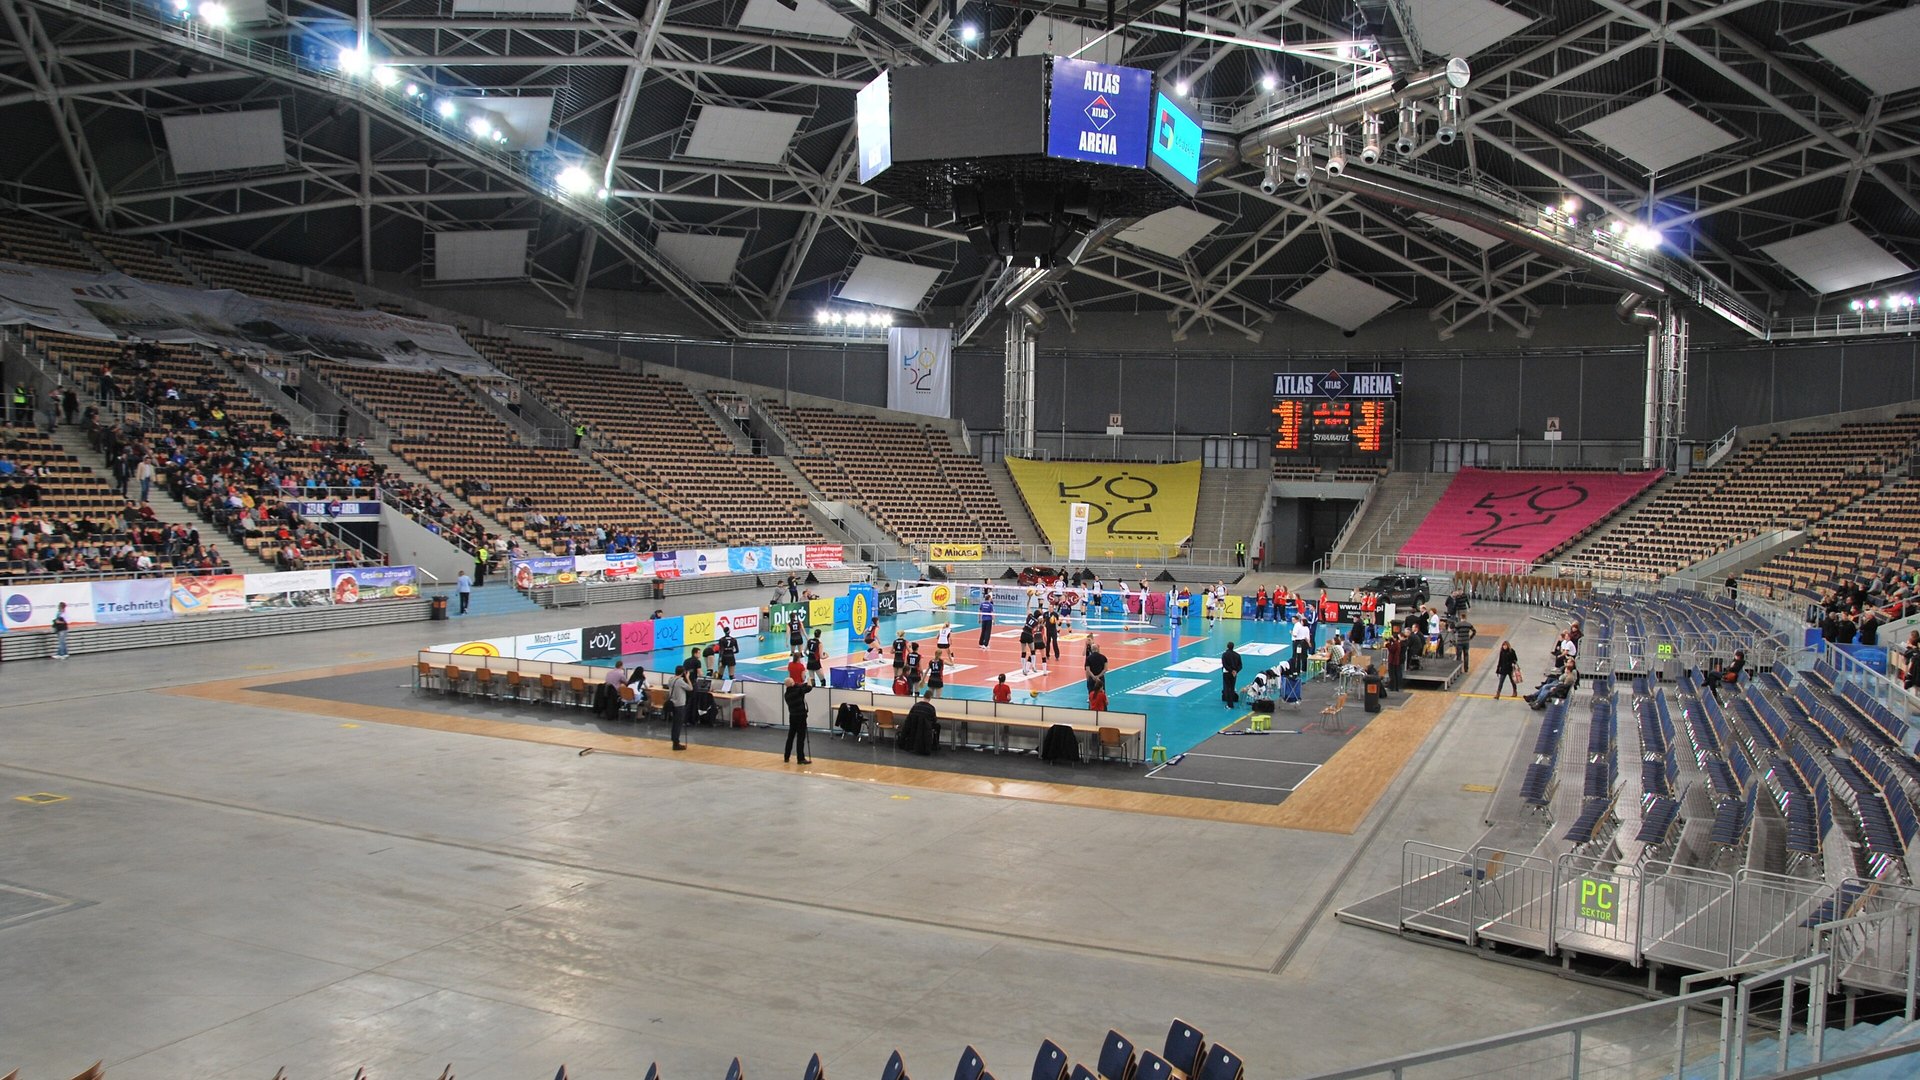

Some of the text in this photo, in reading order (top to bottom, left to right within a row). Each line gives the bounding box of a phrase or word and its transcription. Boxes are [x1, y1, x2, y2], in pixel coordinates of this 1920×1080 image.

[1084, 70, 1120, 95] ATLAS
[1091, 107, 1109, 119] ATLAS
[1079, 131, 1117, 155] ARENA
[1275, 376, 1393, 394] ATLAS ATLAS ARENA
[1112, 416, 1119, 424] U
[1549, 420, 1557, 429] A
[109, 600, 164, 613] Technitel
[734, 616, 757, 629] ORLEN
[534, 634, 551, 644] Mosty
[1581, 880, 1613, 910] PC
[1580, 906, 1612, 921] SEKTOR
